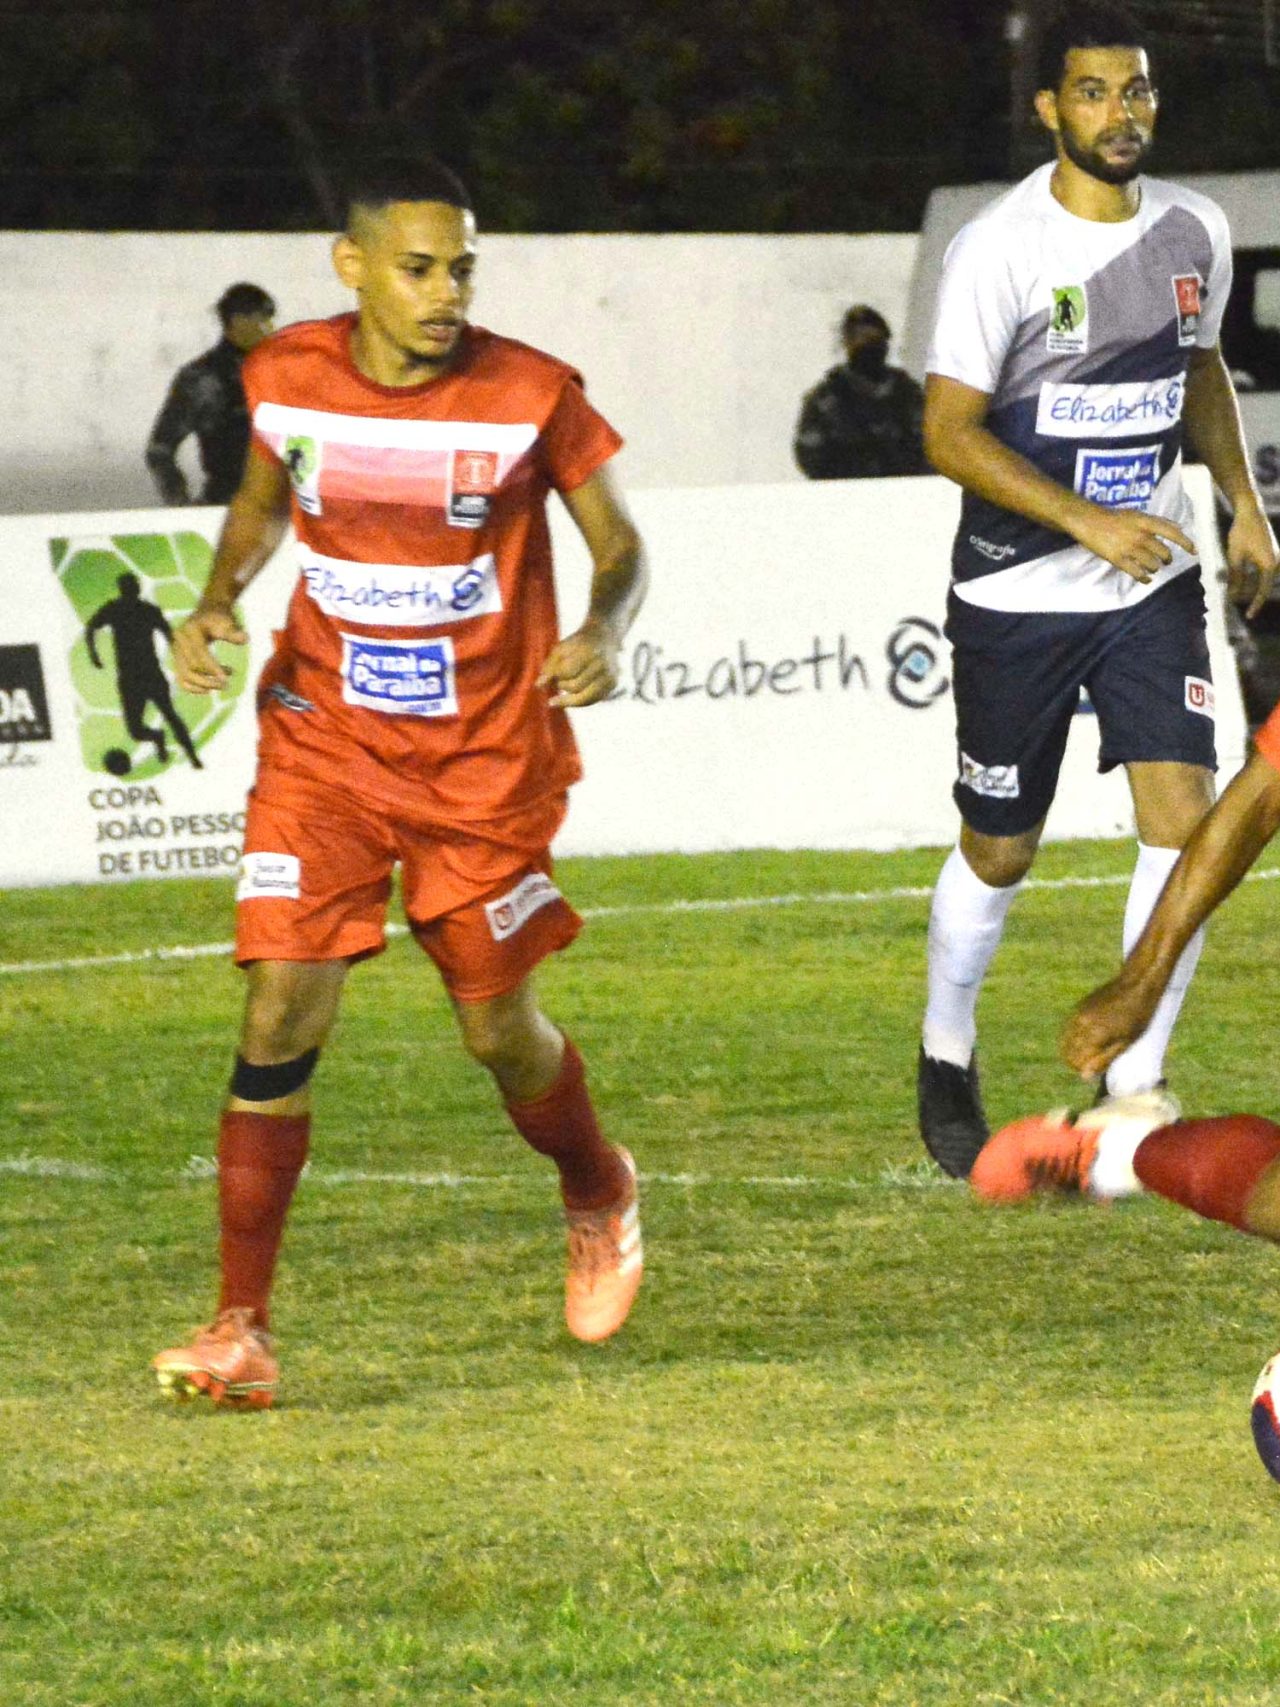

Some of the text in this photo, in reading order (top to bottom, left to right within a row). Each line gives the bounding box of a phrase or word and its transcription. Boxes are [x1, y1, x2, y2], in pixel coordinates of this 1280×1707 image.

[1050, 391, 1163, 423] Elizabeth
[606, 632, 869, 705] lizabeth
[88, 785, 162, 809] COPA
[96, 814, 165, 842] JOÃO
[99, 851, 131, 874] DE
